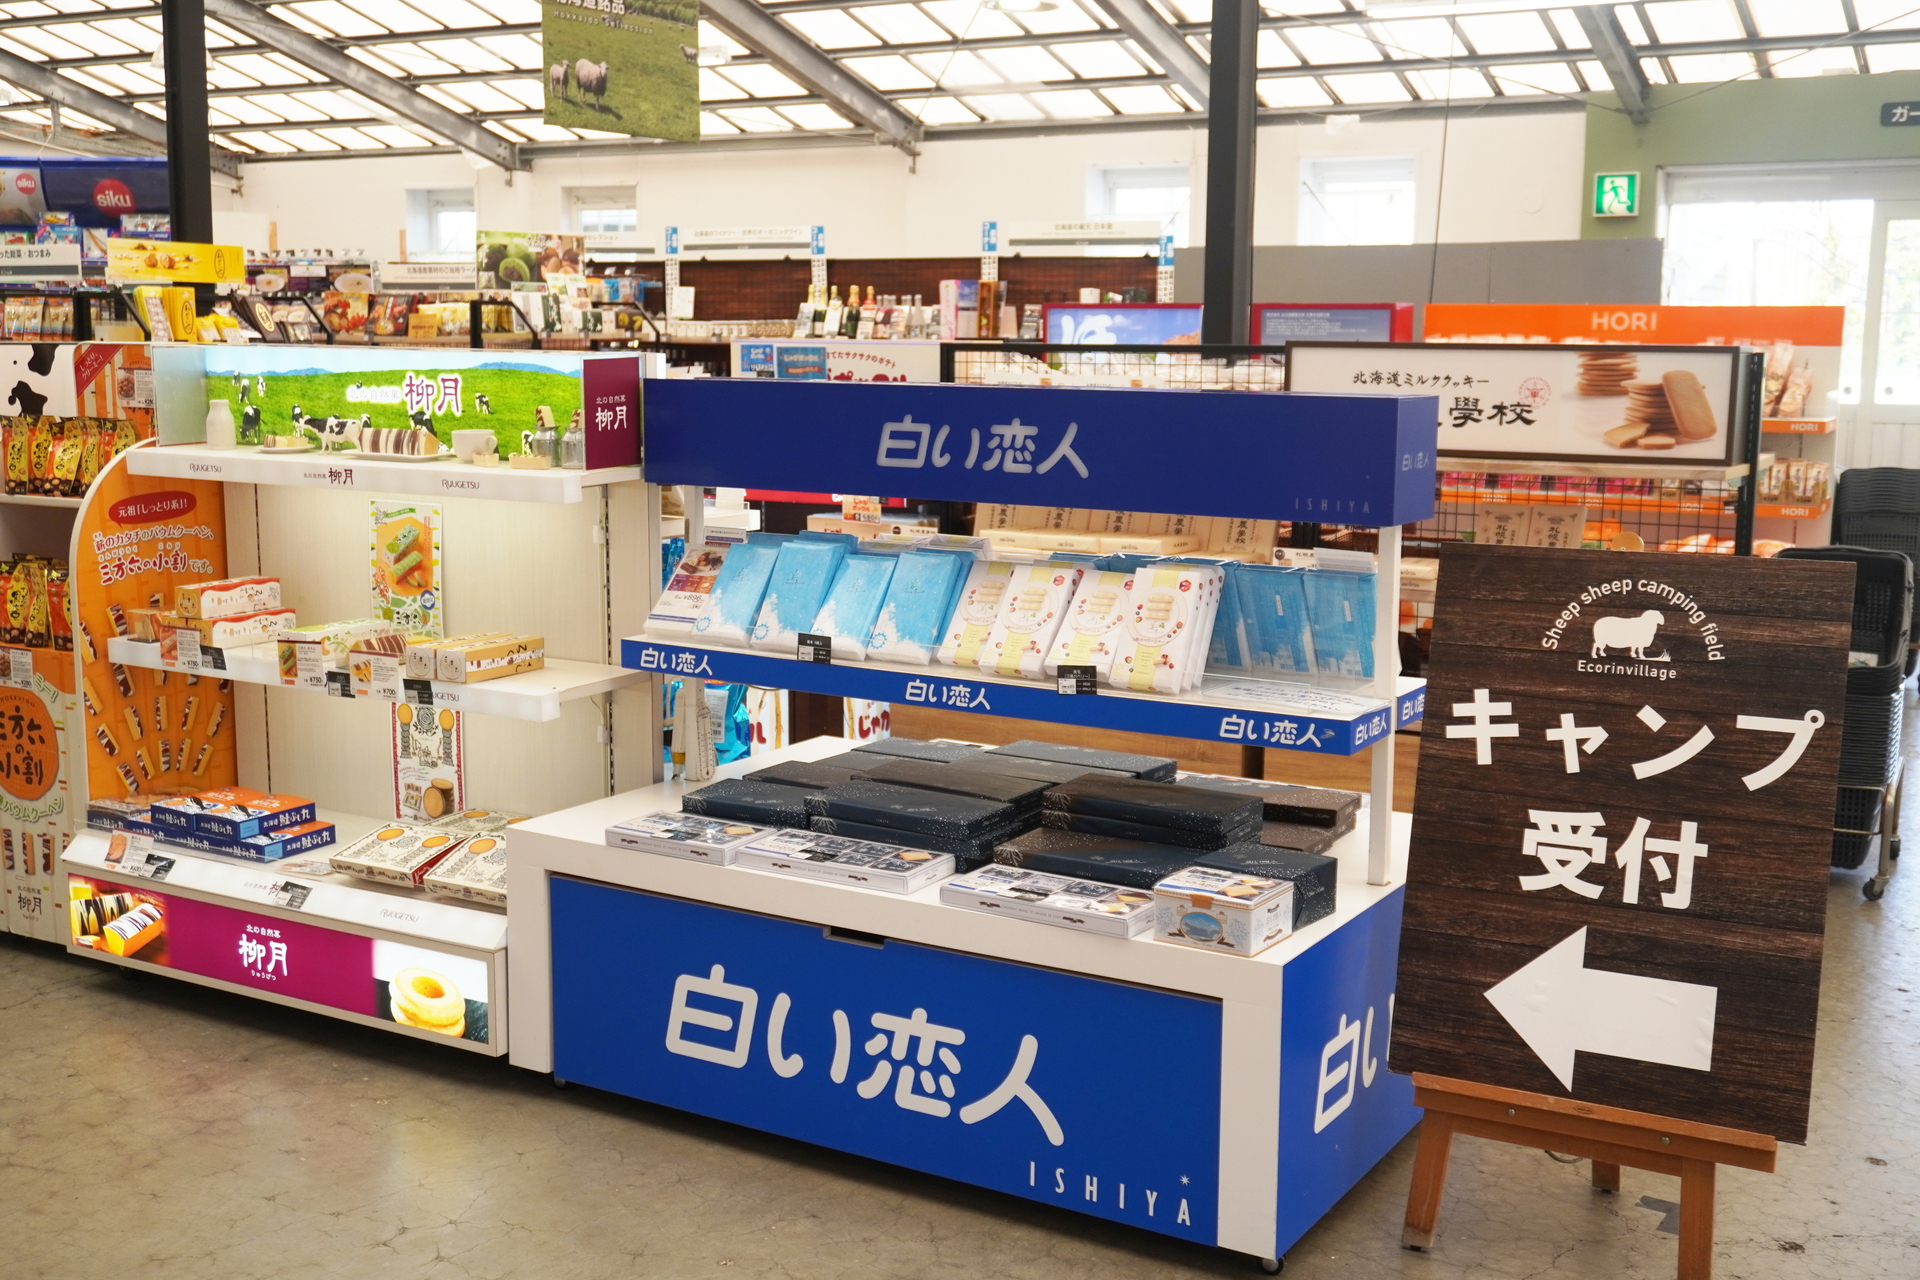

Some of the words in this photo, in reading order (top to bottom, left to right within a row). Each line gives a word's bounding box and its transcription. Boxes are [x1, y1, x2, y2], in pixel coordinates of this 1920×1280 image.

[553, 9, 599, 25] Hokkaido
[17, 179, 35, 189] siku
[97, 190, 132, 207] siku
[1591, 311, 1657, 331] HORI
[1353, 370, 1490, 389] 北海道ミルククッキー
[404, 375, 460, 413] 柳月
[595, 405, 628, 432] 柳月
[1790, 422, 1819, 431] HORI
[875, 414, 1090, 479] 白い恋人
[1401, 451, 1431, 472] 白い恋人
[328, 467, 354, 486] 柳月
[1294, 498, 1372, 515] ISHIYA
[1677, 502, 1704, 512] HORI
[1781, 507, 1809, 516] HORI
[1541, 601, 1581, 651] Sheep
[1581, 579, 1633, 605] sheep
[1637, 578, 1707, 625] camping
[1700, 622, 1726, 661] field
[639, 647, 714, 676] 白い恋人
[1577, 660, 1678, 681] Ecorinvillage
[905, 678, 991, 711] 白い恋人
[1219, 714, 1322, 749] 白い恋人
[1355, 712, 1387, 744] 白い恋人
[1445, 688, 1826, 792] キャンプ
[1518, 809, 1709, 910] 受付
[17, 892, 43, 915] 柳月
[238, 933, 288, 977] 柳月
[665, 964, 1065, 1146] 白い恋人
[1029, 1161, 1192, 1227] ISHIYA
